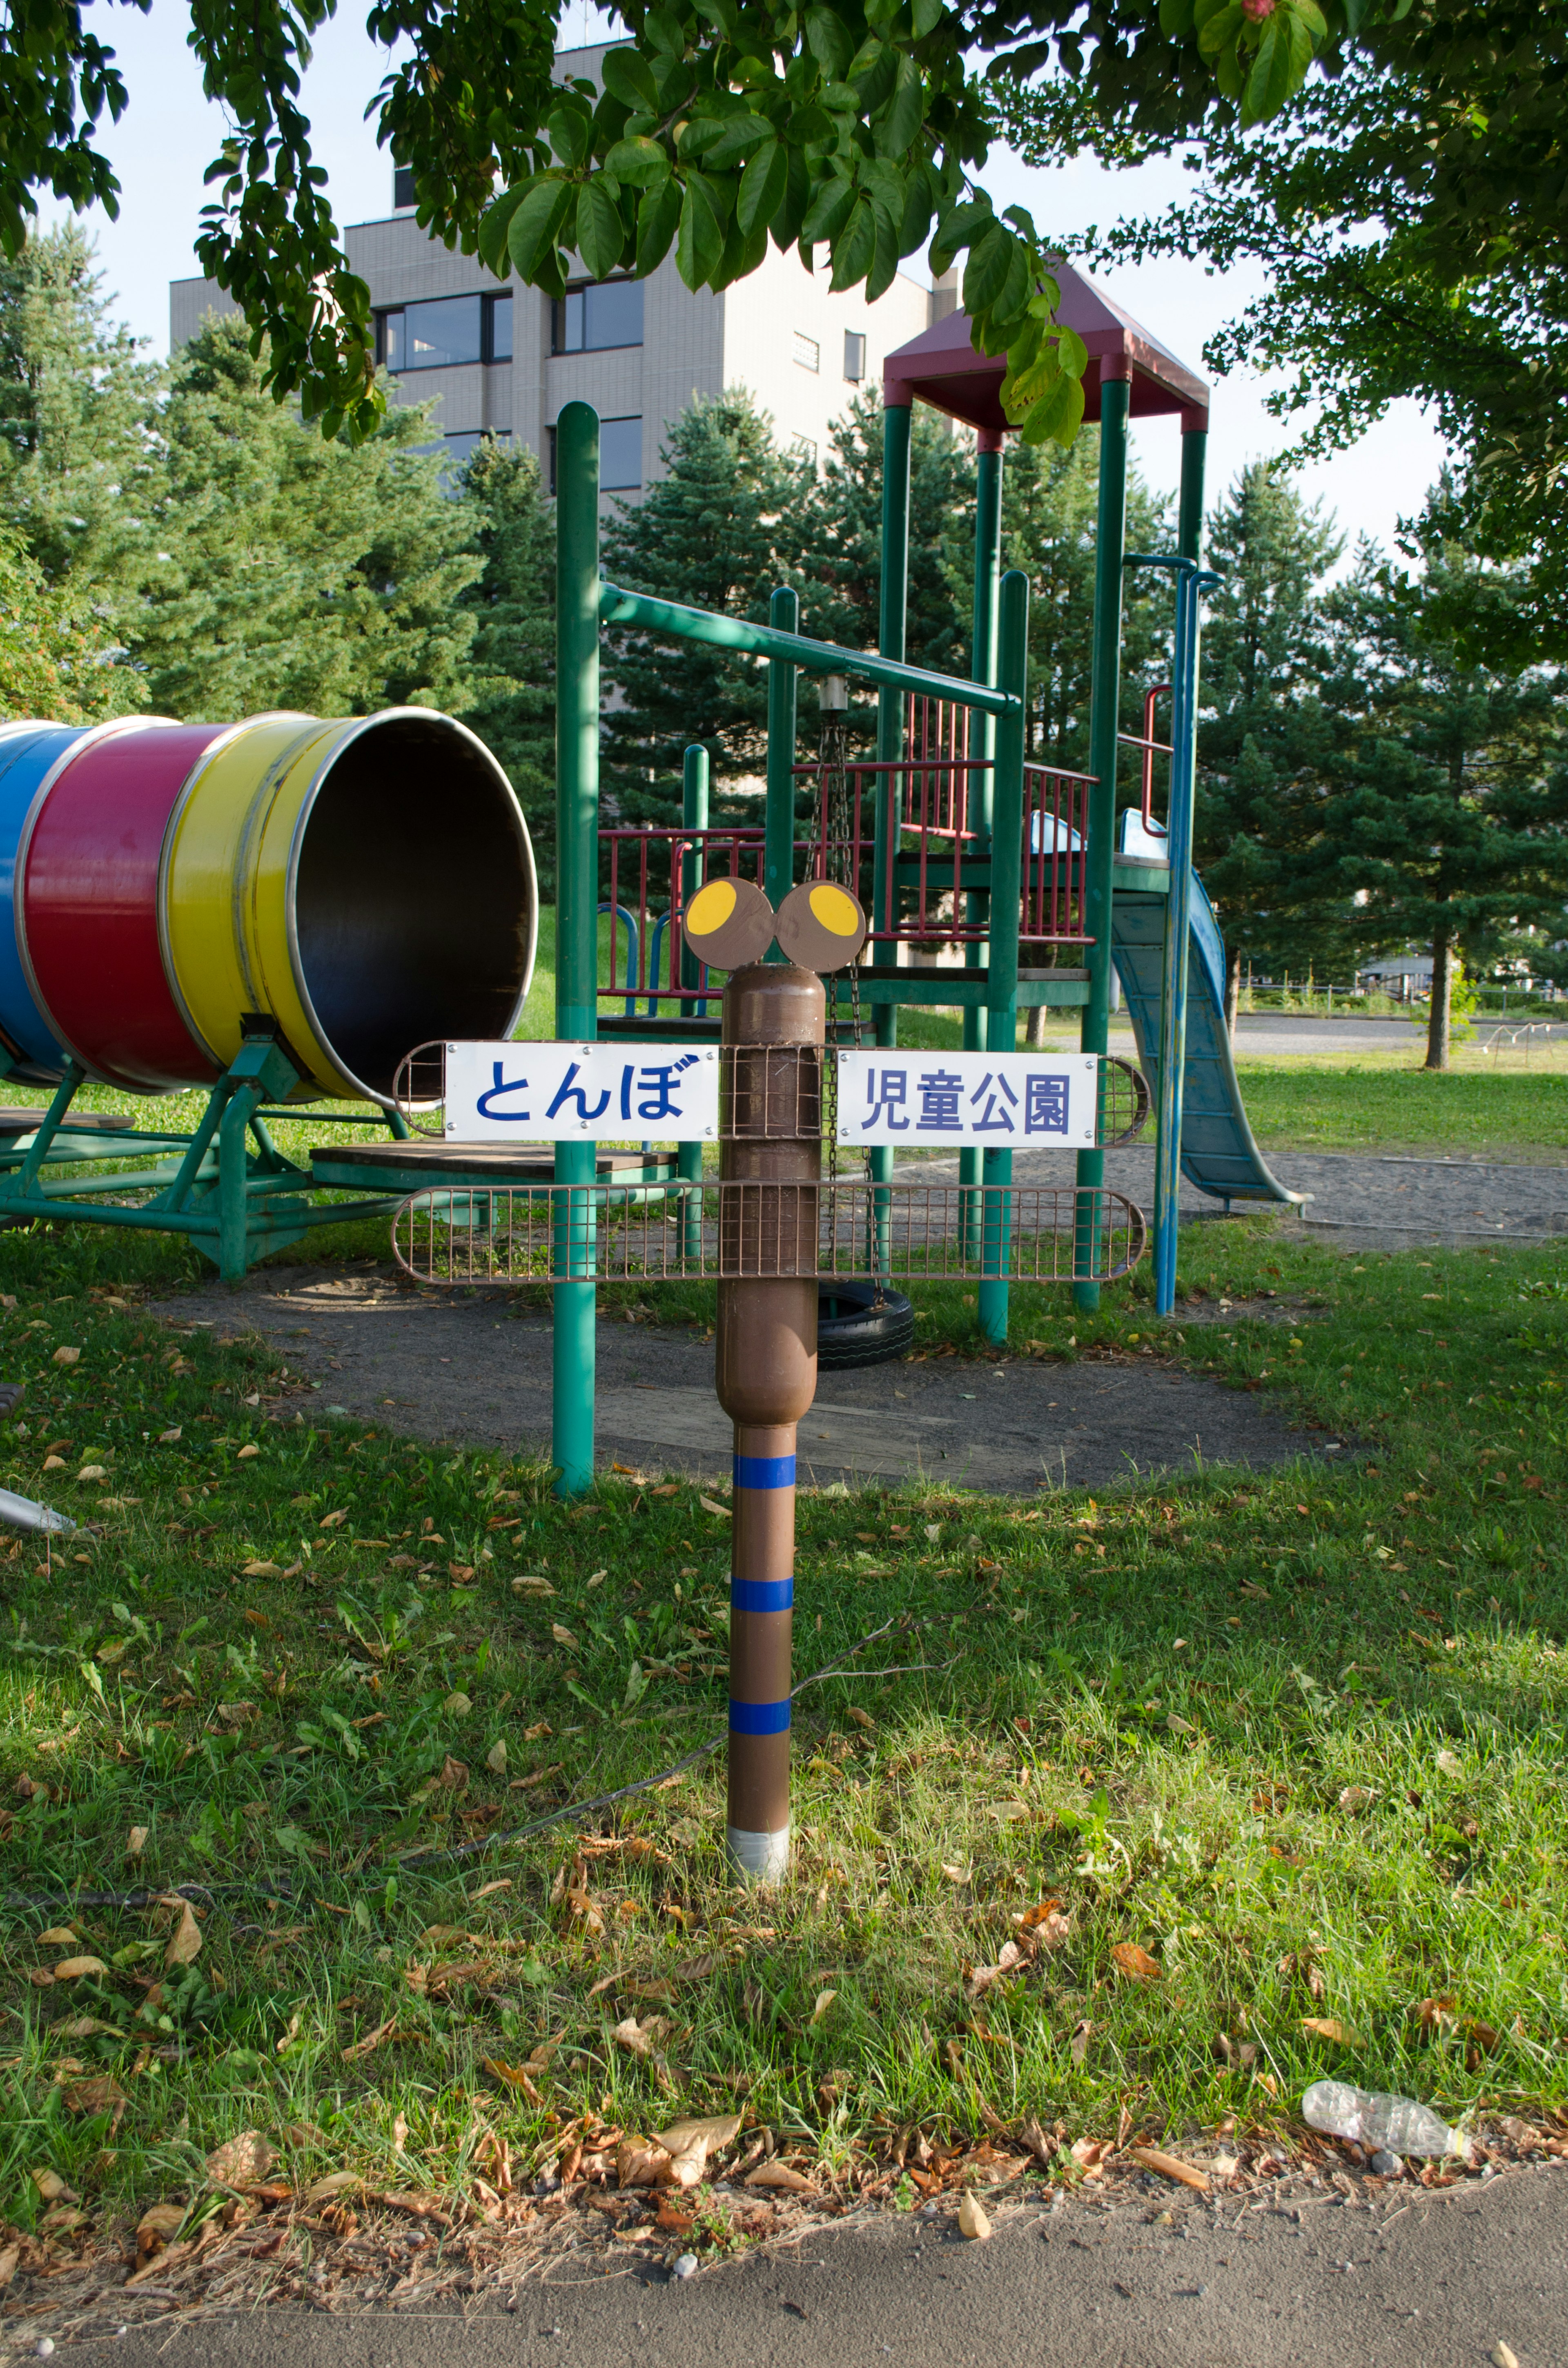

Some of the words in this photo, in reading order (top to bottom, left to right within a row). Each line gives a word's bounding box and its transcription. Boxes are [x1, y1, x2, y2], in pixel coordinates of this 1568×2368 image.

[476, 1054, 699, 1121] とんぼ
[862, 1068, 1070, 1135] 児童公園
